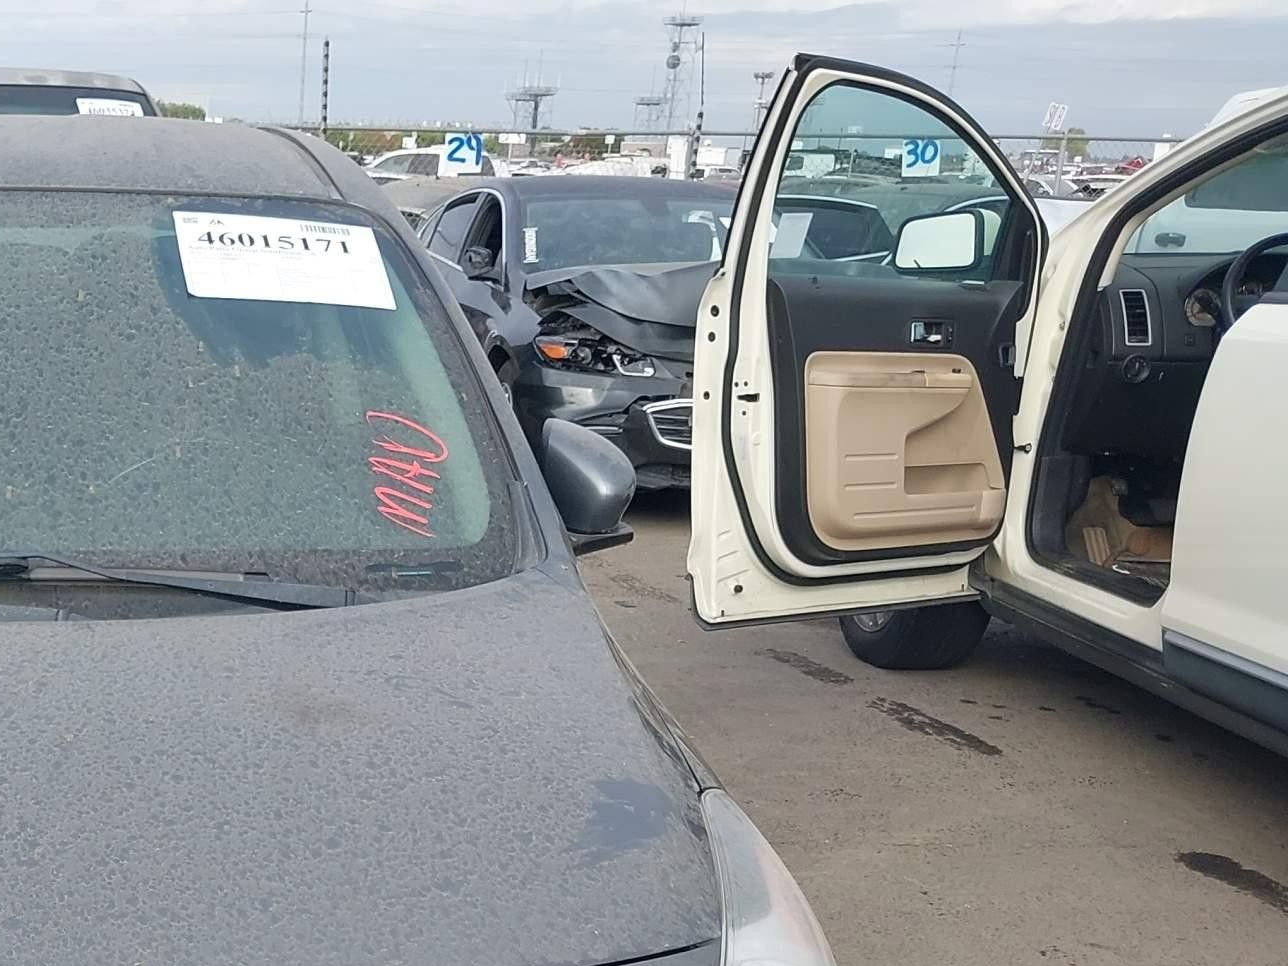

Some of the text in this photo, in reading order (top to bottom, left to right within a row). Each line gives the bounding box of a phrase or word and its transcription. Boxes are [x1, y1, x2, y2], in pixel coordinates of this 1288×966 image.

[446, 132, 483, 166] 29
[903, 138, 942, 168] 30
[197, 230, 350, 254] 46015171
